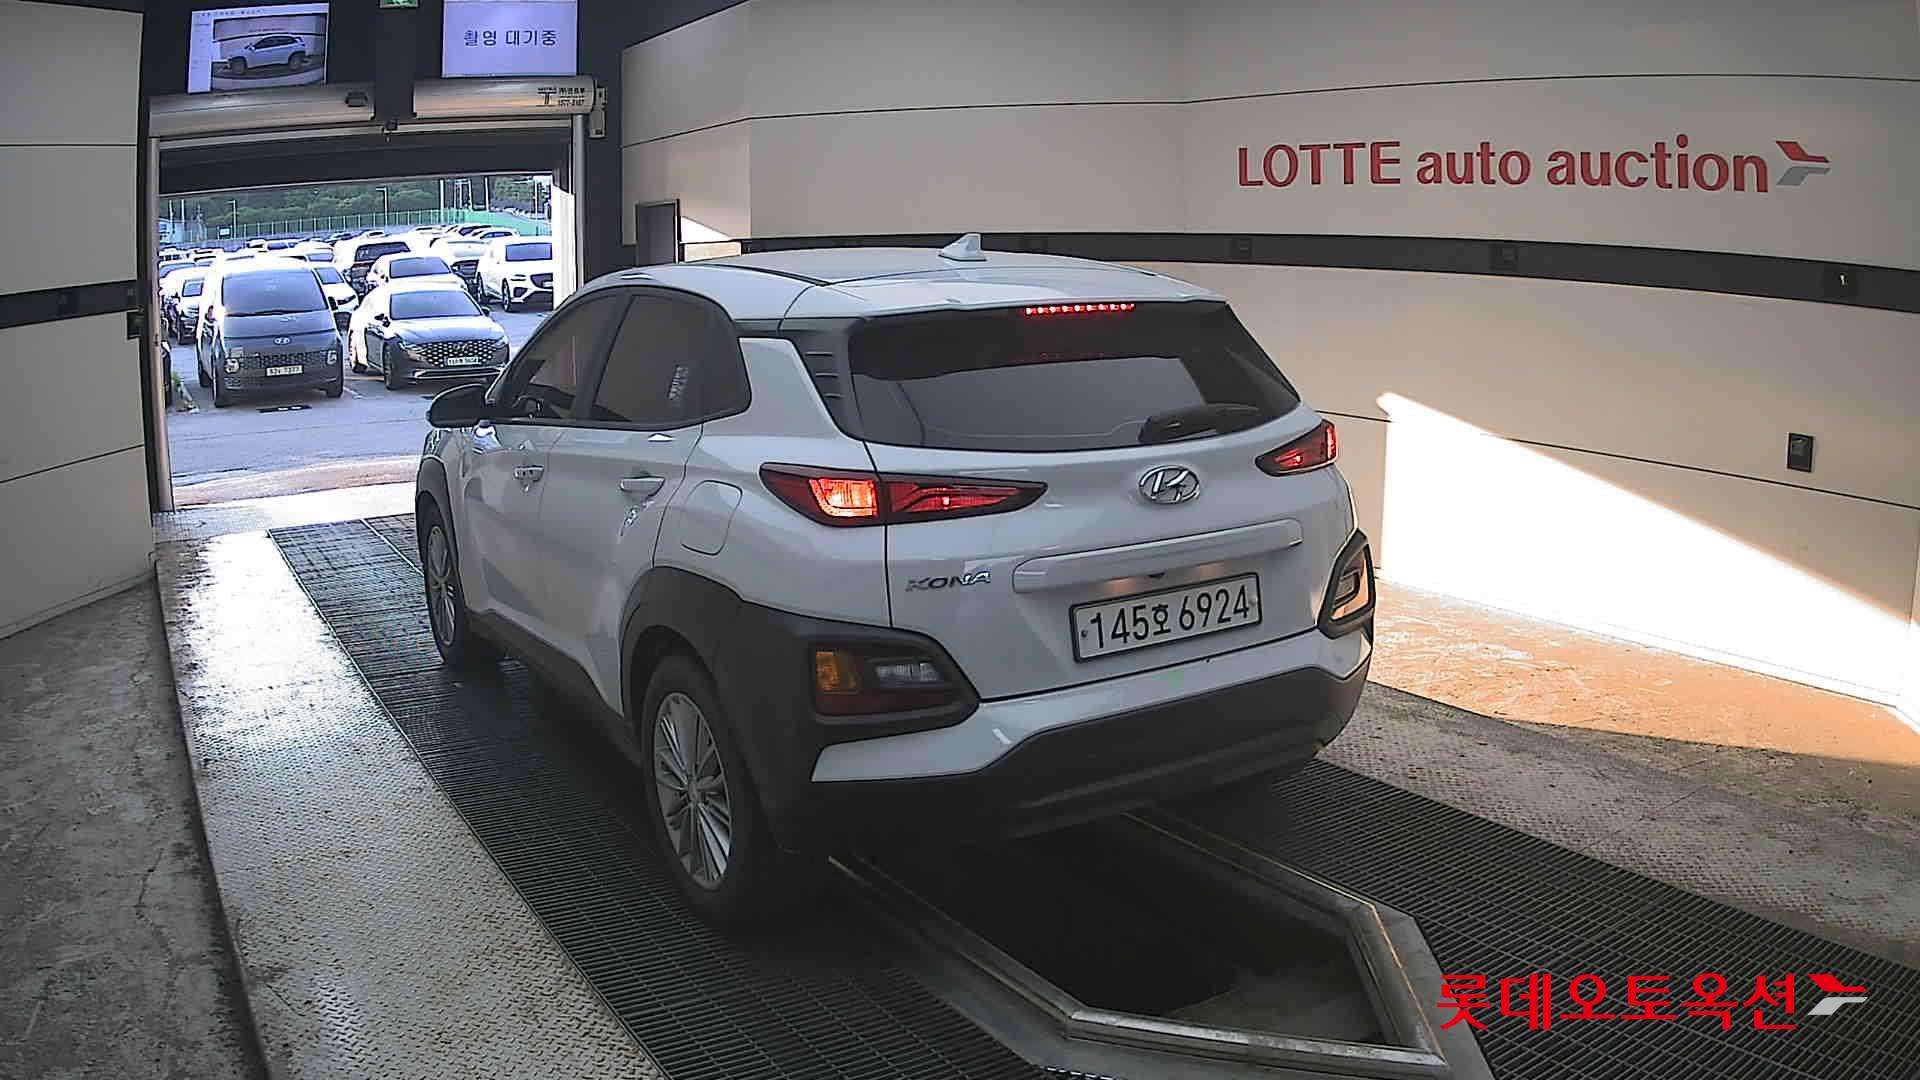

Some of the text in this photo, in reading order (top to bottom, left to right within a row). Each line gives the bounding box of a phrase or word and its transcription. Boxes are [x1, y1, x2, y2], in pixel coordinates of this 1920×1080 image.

[505, 30, 557, 47] 대기중
[1238, 134, 1768, 193] LOTTE auto auction
[904, 570, 992, 593] KONA
[1090, 584, 1250, 649] 145호 6924
